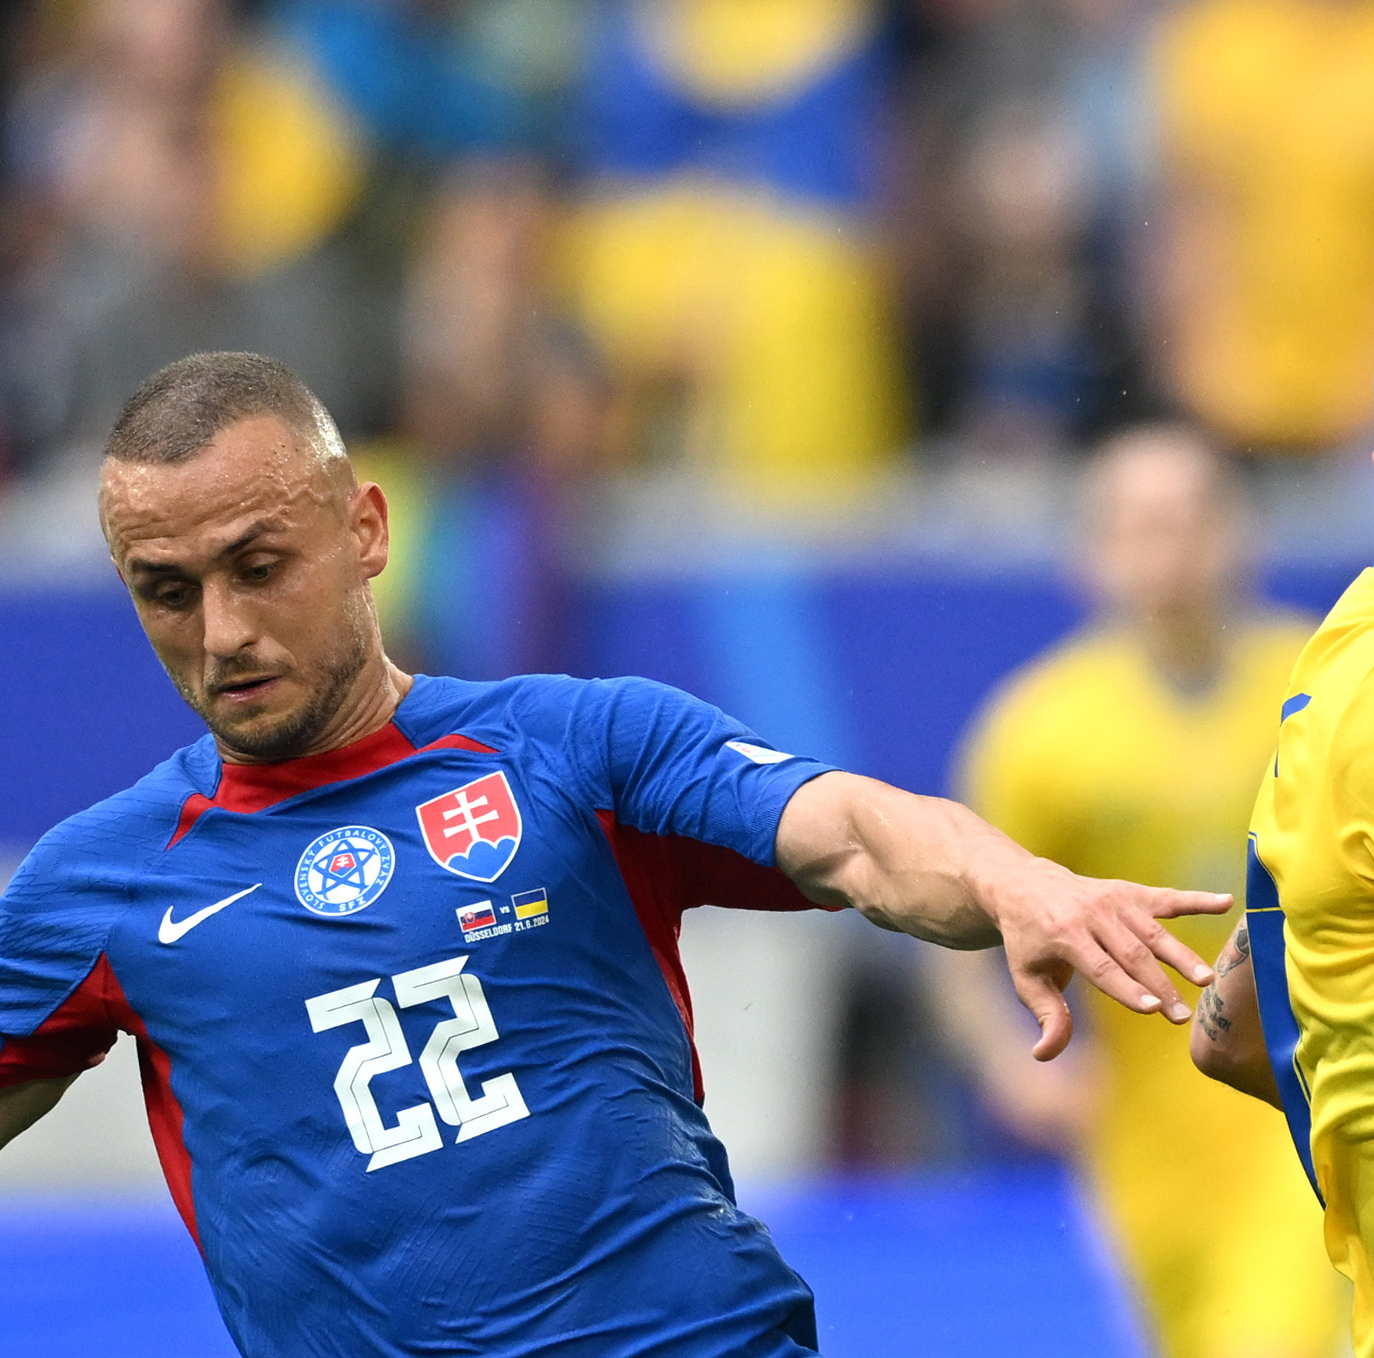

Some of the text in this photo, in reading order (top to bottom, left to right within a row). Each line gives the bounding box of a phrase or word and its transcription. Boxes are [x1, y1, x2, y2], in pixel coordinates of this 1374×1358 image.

[338, 896, 368, 912] SFZ
[464, 923, 513, 943] DÜSSELDORF
[304, 953, 532, 1174] 22
